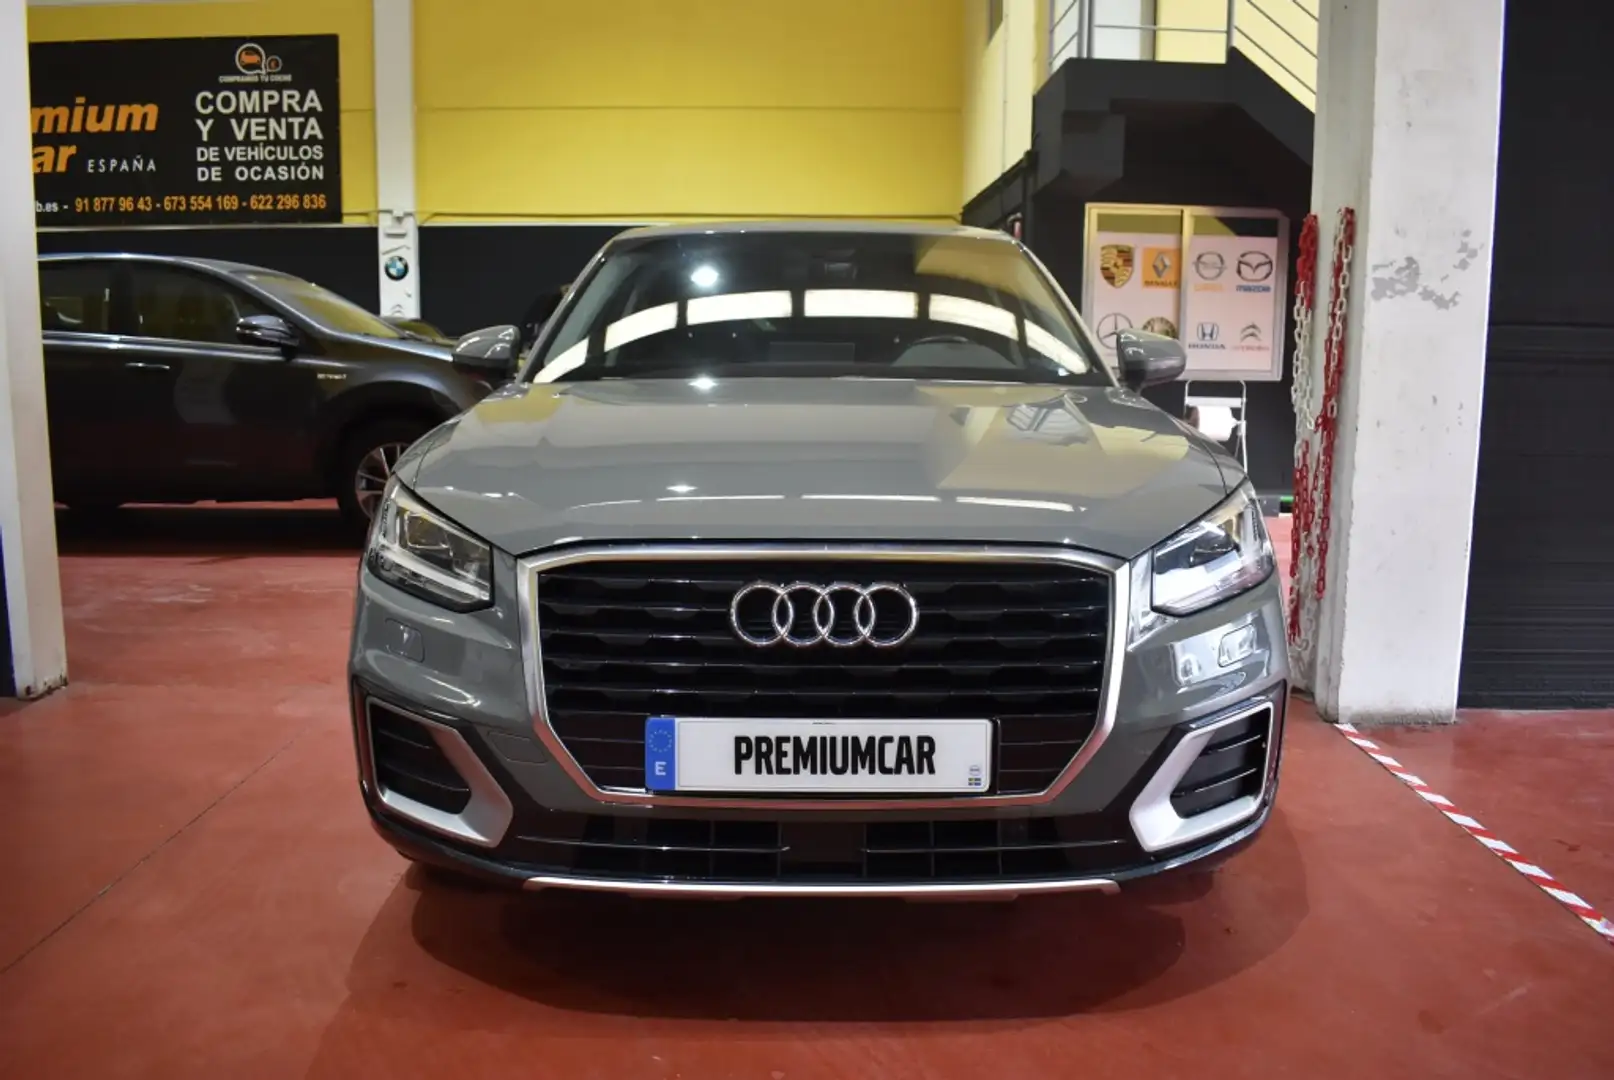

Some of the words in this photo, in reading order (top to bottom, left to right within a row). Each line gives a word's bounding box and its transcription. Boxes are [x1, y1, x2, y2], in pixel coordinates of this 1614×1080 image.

[195, 89, 323, 114] COMPRA
[194, 118, 214, 141] Y
[230, 117, 324, 141] VENTA
[196, 146, 220, 161] DE
[224, 142, 324, 161] VEHÍCULOS
[87, 154, 156, 173] ESPAÑA
[197, 166, 222, 181] DE
[235, 162, 324, 181] OCASIÓN
[75, 197, 90, 212] 91
[93, 197, 115, 212] 877
[118, 196, 134, 212] 96
[137, 196, 152, 211] 43
[163, 195, 186, 211] 673
[190, 195, 212, 211] 554
[216, 195, 238, 210] 169
[250, 194, 273, 210] 622
[276, 194, 299, 210] 296
[302, 194, 326, 209] 836
[734, 735, 936, 776] PREMIUMCAR
[654, 761, 667, 775] E
